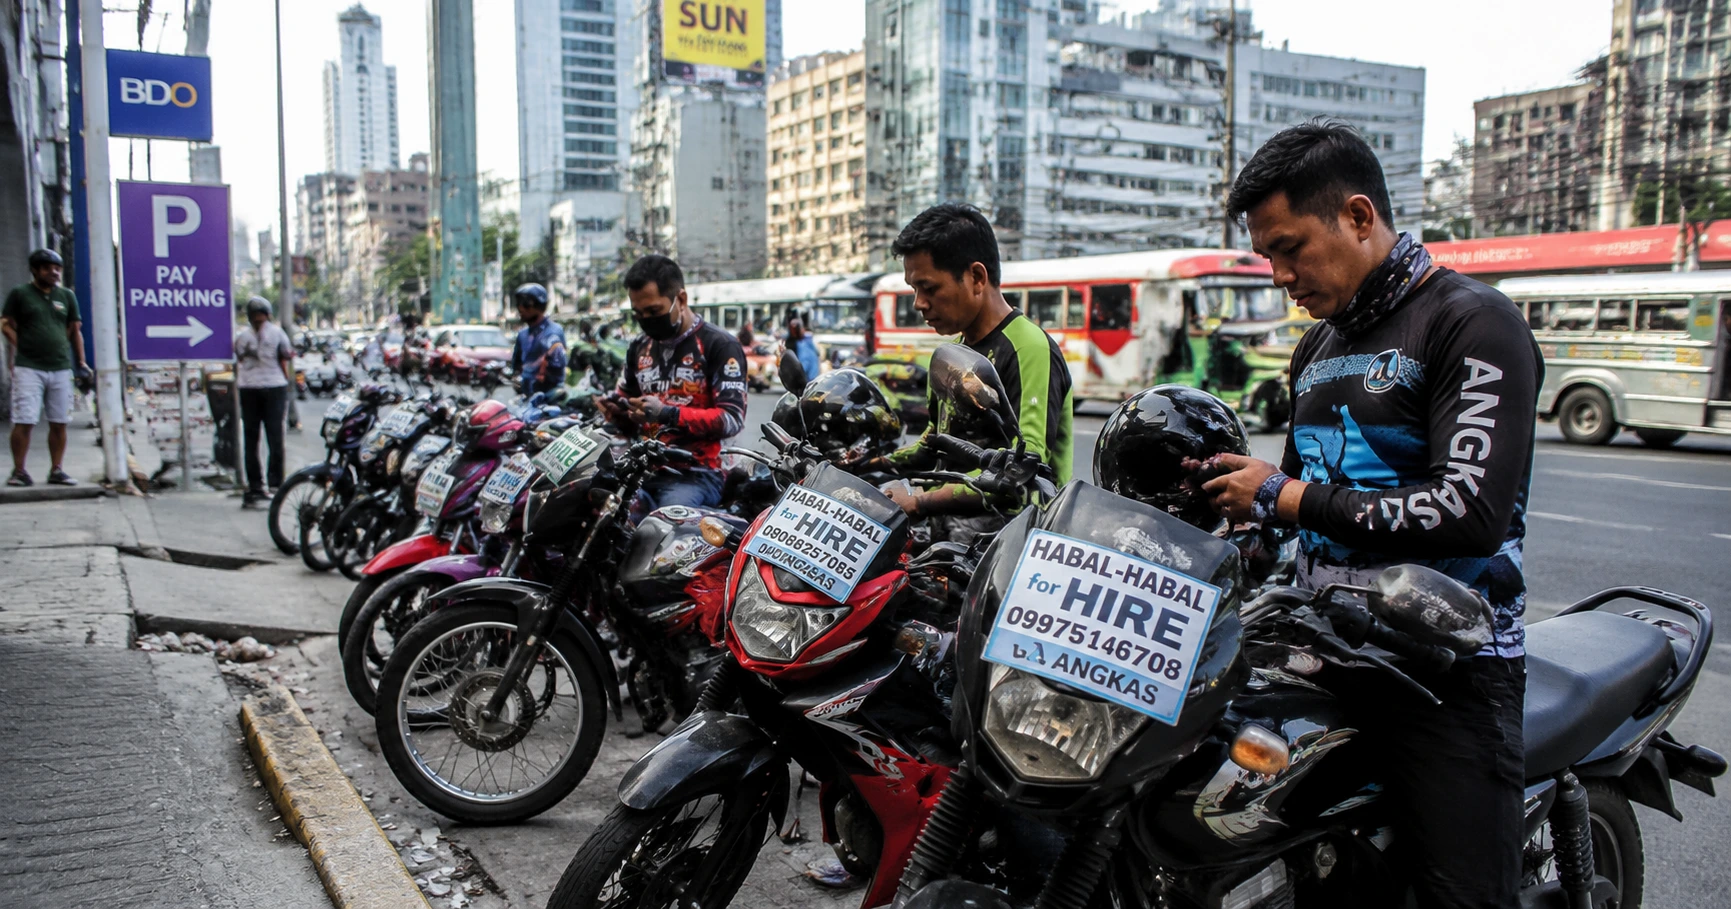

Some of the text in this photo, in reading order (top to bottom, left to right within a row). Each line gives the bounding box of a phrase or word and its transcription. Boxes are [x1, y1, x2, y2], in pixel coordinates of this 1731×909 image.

[679, 0, 747, 34] SUN
[120, 77, 198, 108] BDO
[152, 194, 202, 258] P
[130, 288, 226, 307] PARKING
[156, 265, 197, 285] PAY
[779, 507, 868, 563] for HIRE
[786, 488, 881, 544] HABAL-HABAL
[1030, 538, 1206, 613] HABAL-HABAL
[1026, 573, 1190, 651] for HIRE
[1006, 606, 1182, 681] 09975146708
[1051, 652, 1159, 706] ANGKAS
